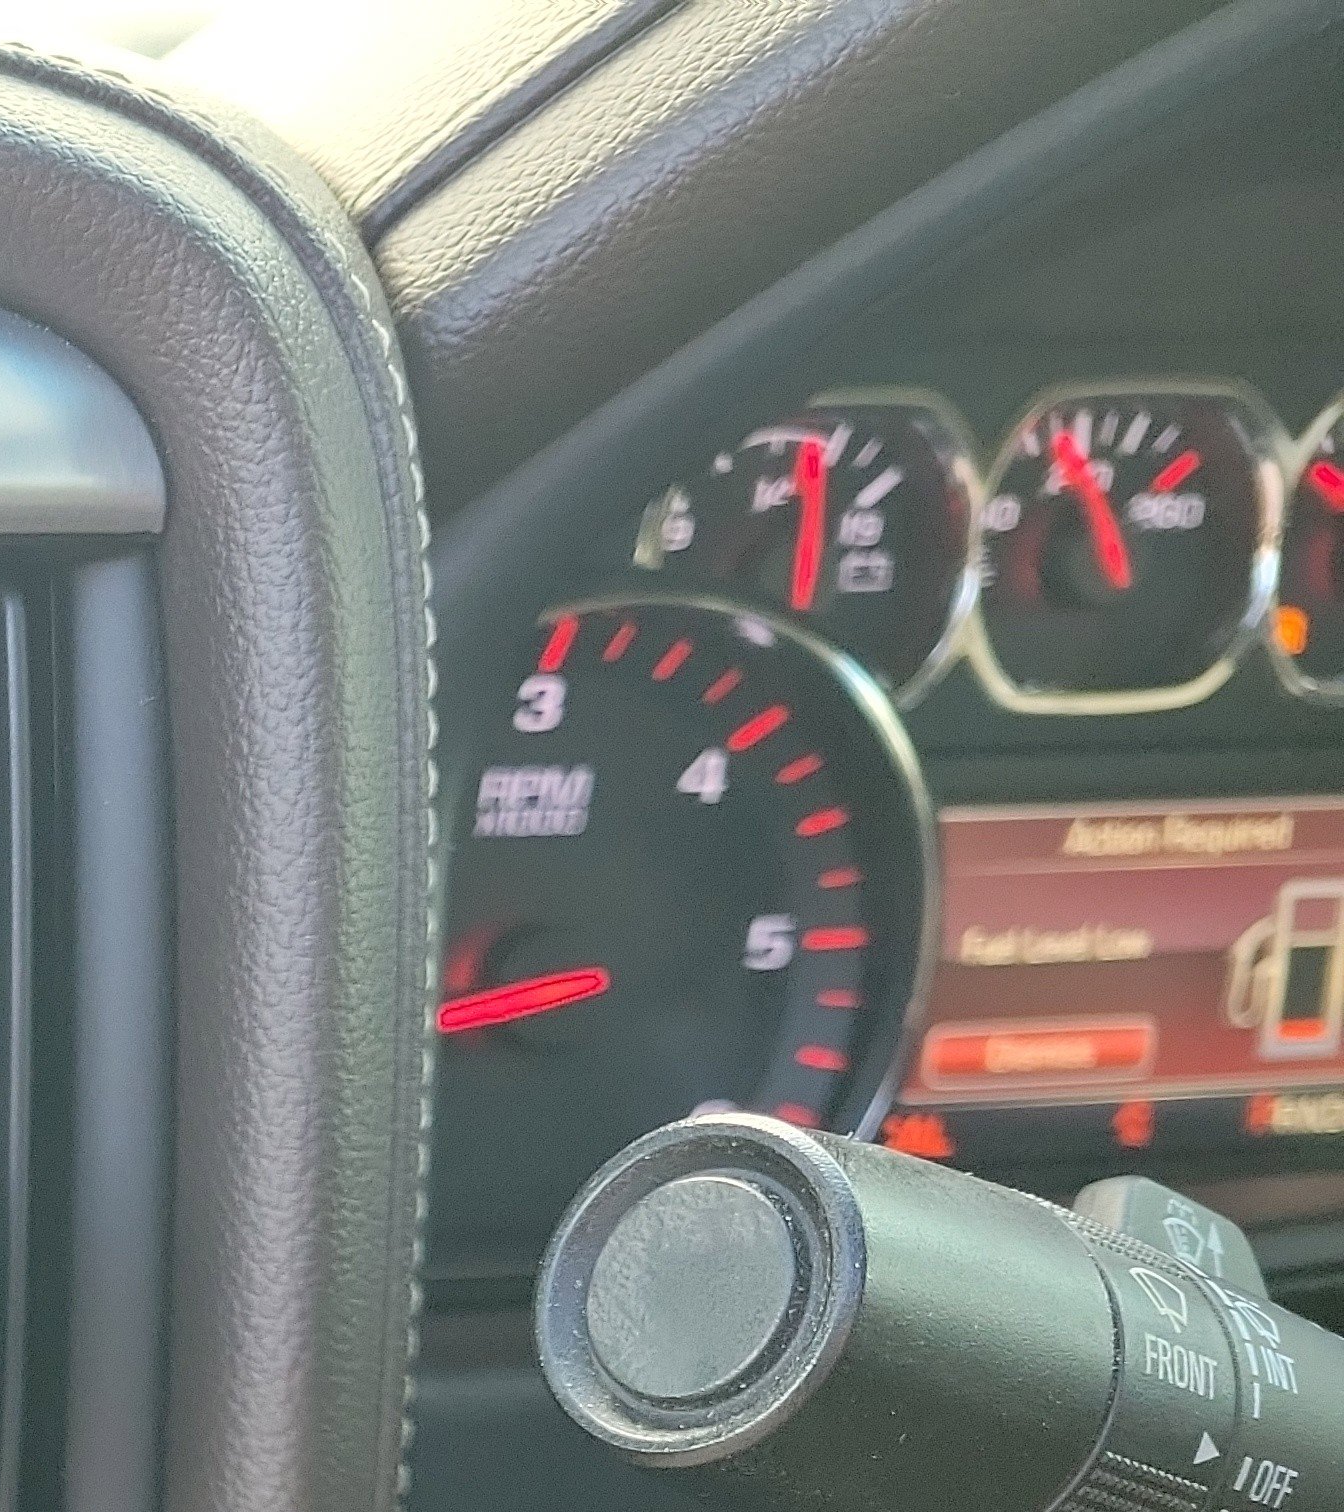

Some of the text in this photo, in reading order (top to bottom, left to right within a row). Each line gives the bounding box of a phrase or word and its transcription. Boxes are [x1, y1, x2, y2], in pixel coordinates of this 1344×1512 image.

[512, 673, 566, 733] 3
[477, 764, 595, 811] RPM
[675, 747, 728, 805] 4
[742, 912, 797, 971] 5
[1143, 1332, 1218, 1401] FRONT
[1260, 1344, 1299, 1395] INT
[1249, 1459, 1301, 1509] OFF
